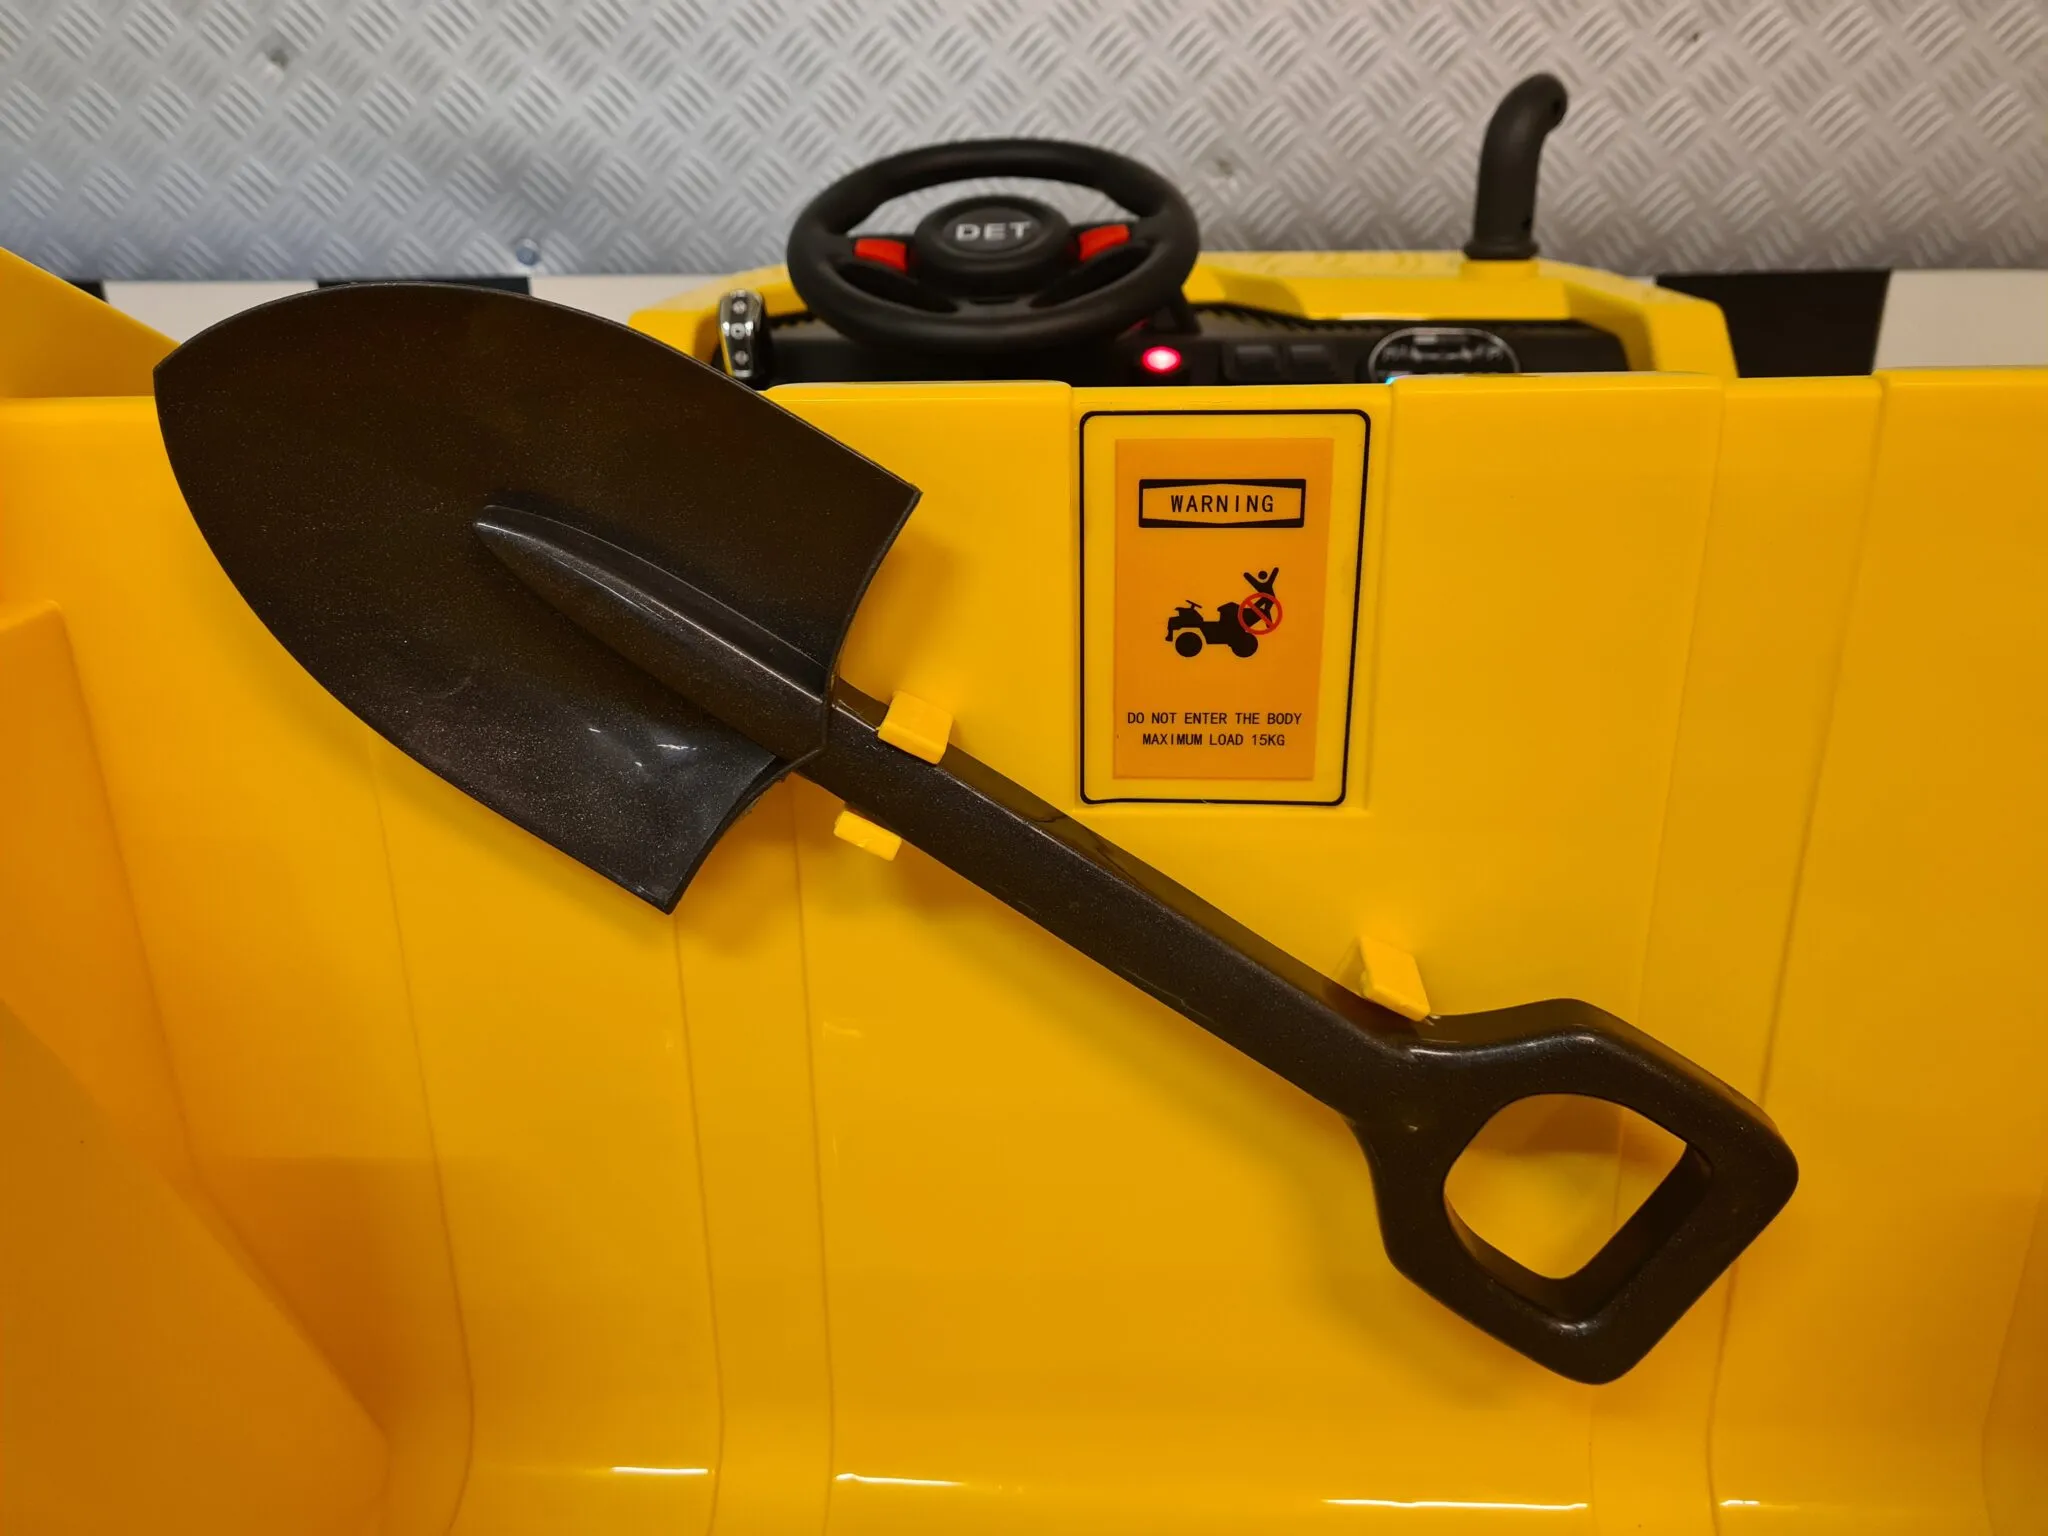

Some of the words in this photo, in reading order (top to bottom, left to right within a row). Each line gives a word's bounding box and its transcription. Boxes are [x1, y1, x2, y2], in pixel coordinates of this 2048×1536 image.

[955, 221, 1033, 242] DET
[1170, 494, 1275, 513] WARNING
[1127, 711, 1145, 724] DO
[1151, 711, 1177, 725] NOT
[1184, 712, 1228, 725] ENTER
[1235, 712, 1260, 725] THE
[1266, 712, 1302, 726] BODY
[1142, 733, 1203, 746] MAXIMUM
[1209, 733, 1244, 746] LOAD
[1251, 734, 1285, 747] 15KG
